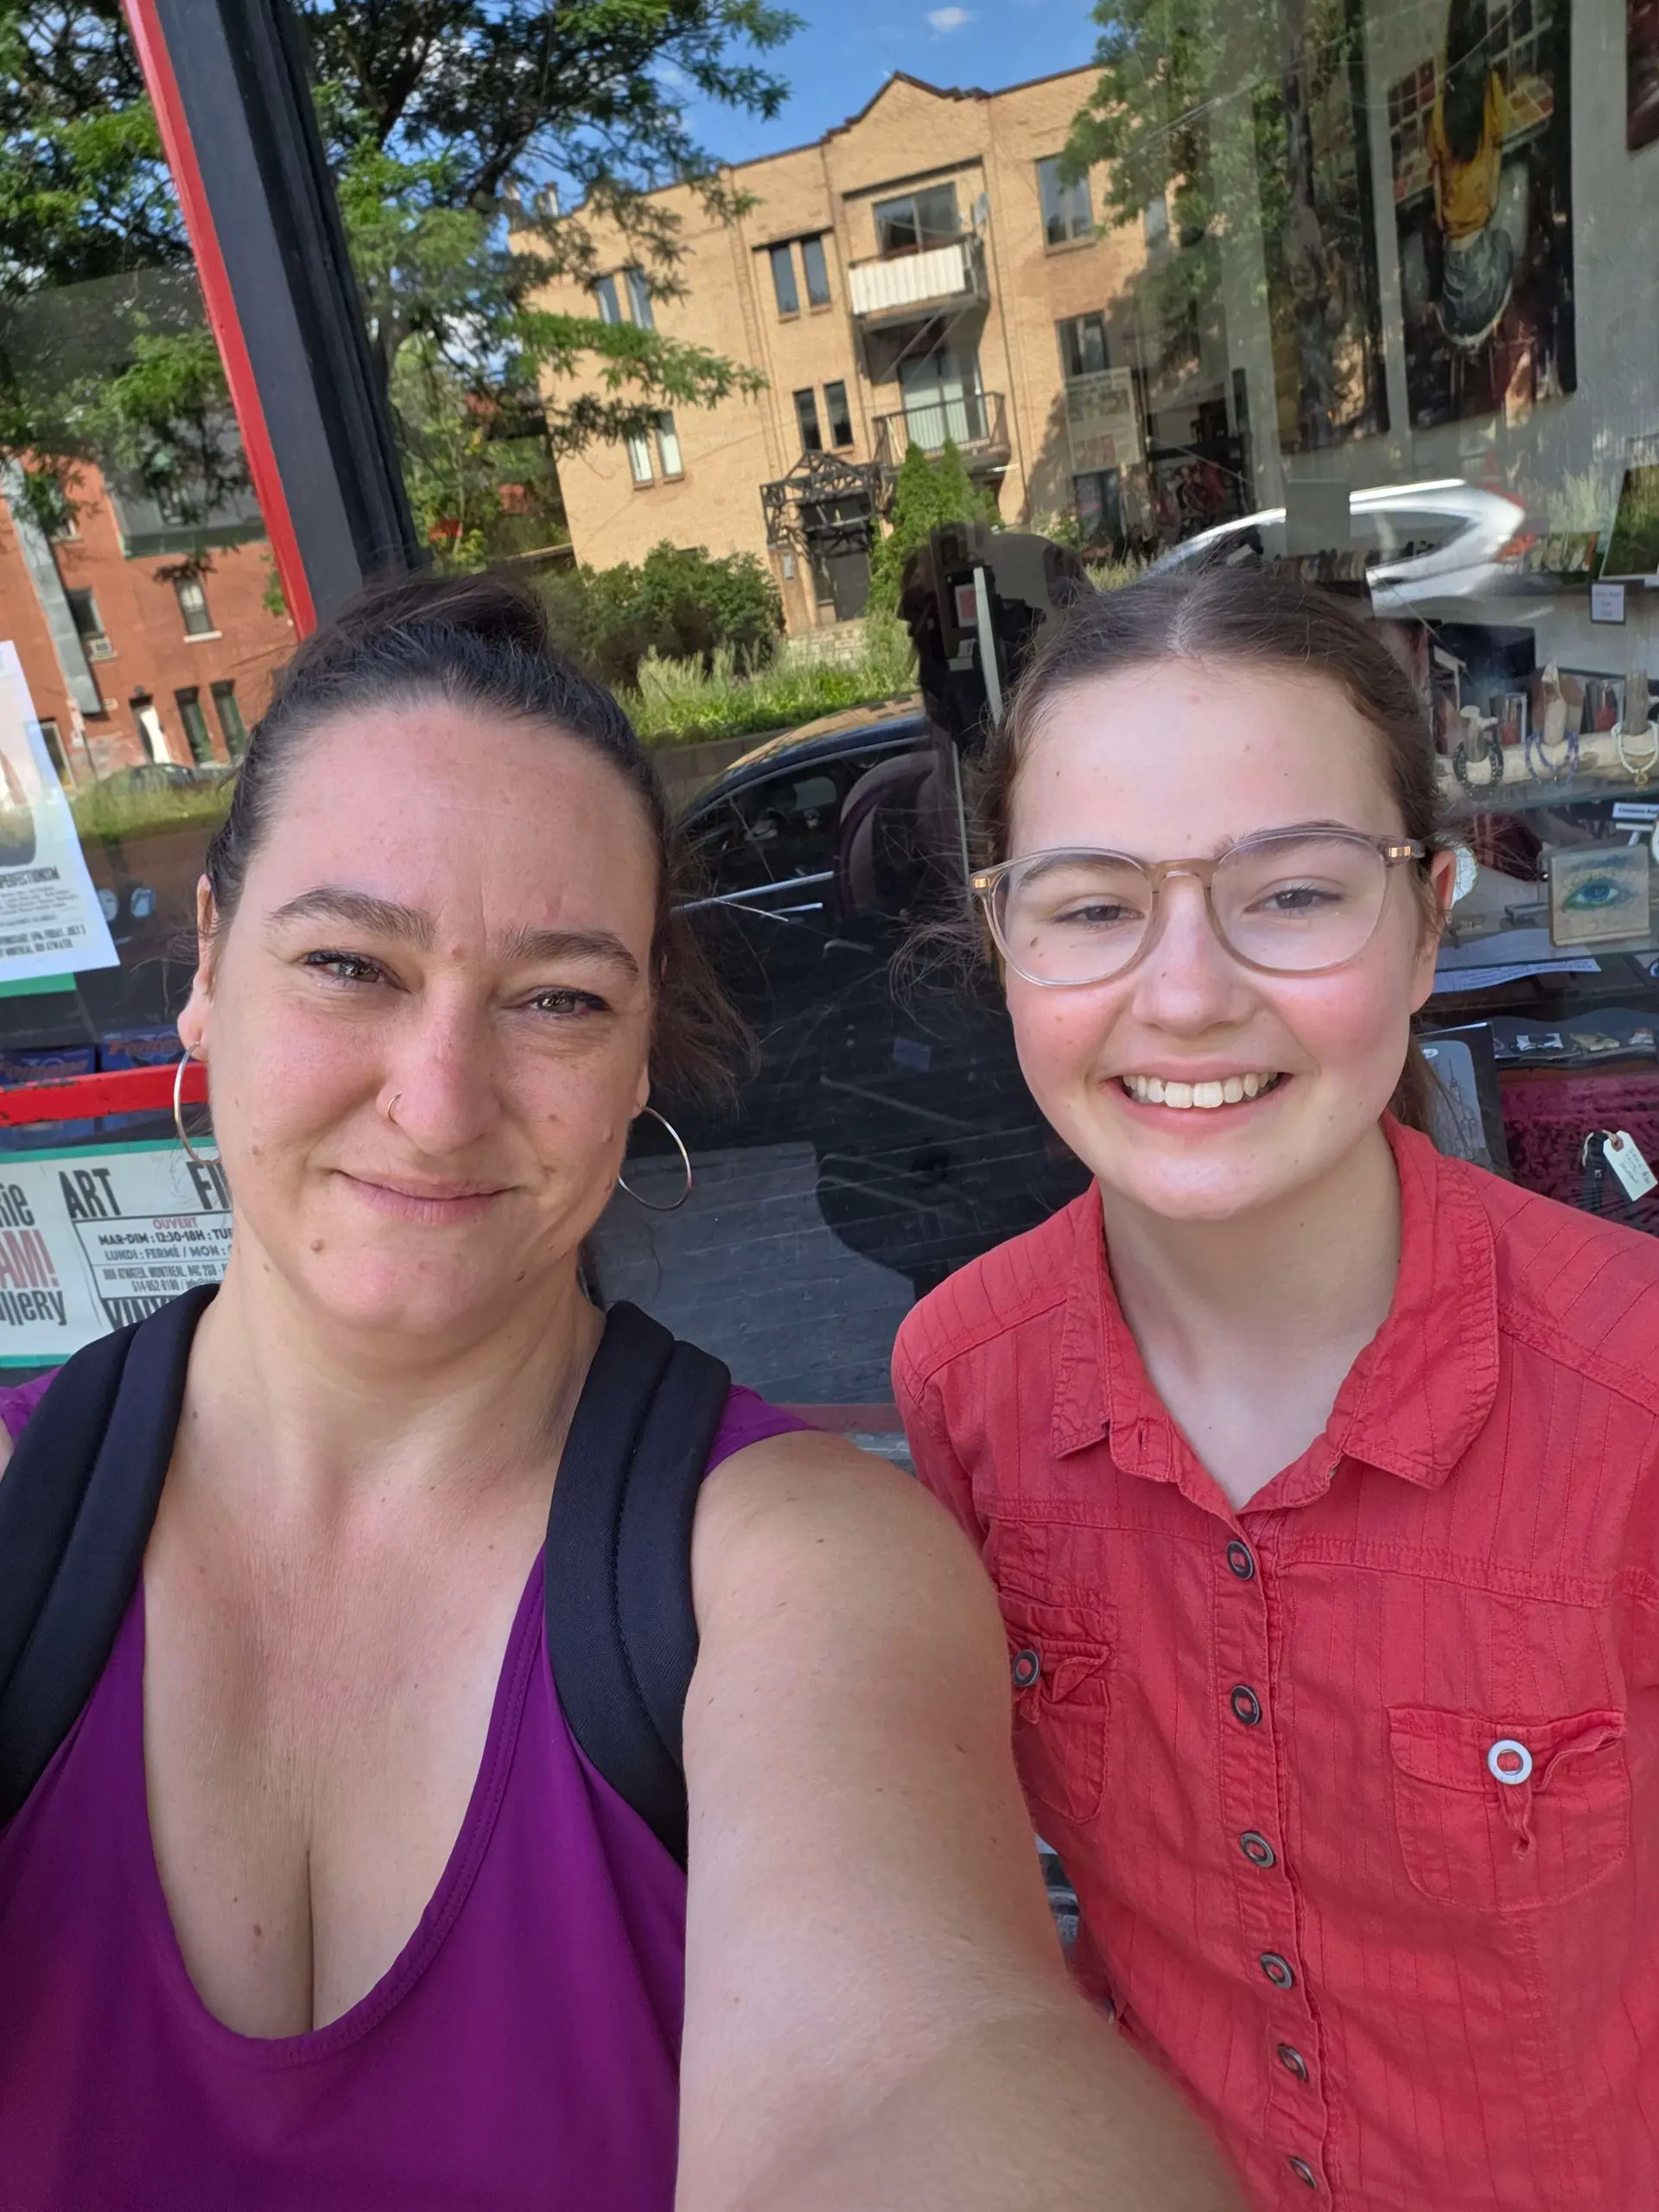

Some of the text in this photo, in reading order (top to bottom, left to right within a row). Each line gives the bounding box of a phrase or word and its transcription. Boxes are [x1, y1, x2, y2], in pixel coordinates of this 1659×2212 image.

[59, 1167, 122, 1219] ART
[152, 1217, 199, 1230] OUVERT
[98, 1232, 149, 1246] MAR-DIM
[156, 1230, 207, 1243] 12:30-18H
[103, 1249, 139, 1262] LUNDI
[144, 1245, 181, 1259] FERMÉ
[189, 1244, 219, 1257] MON
